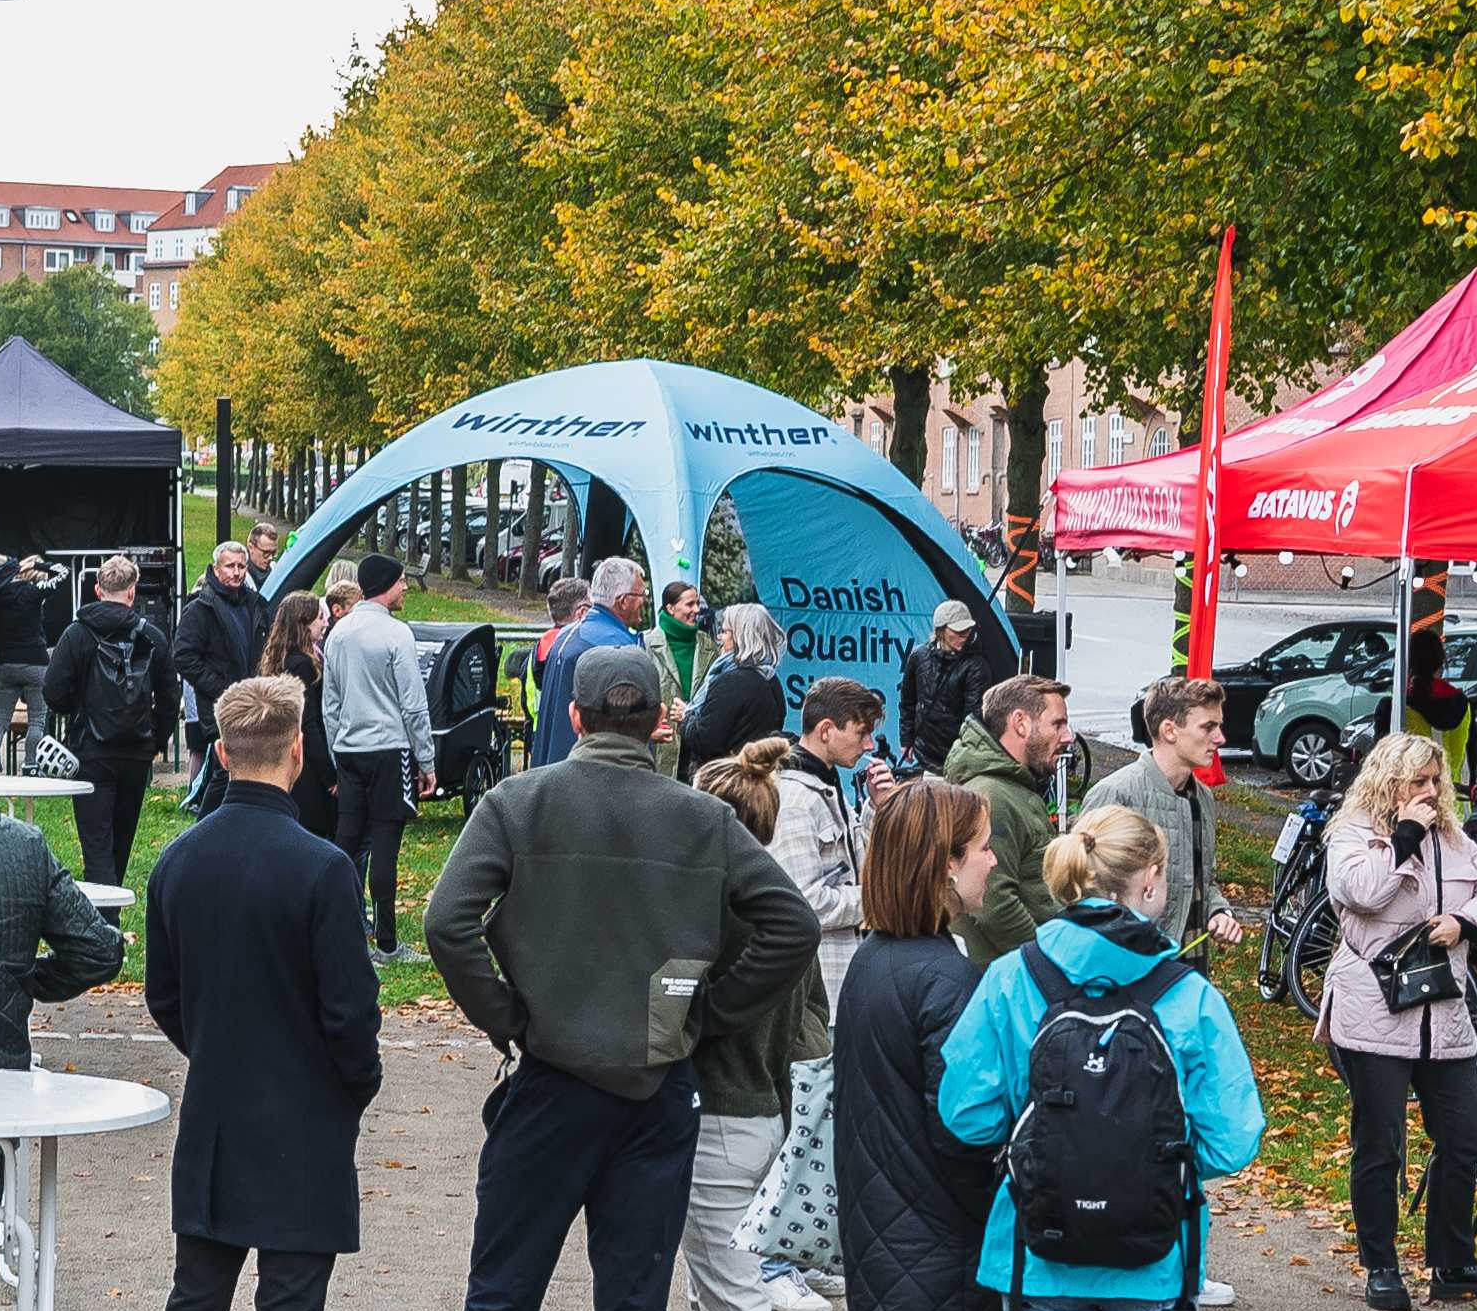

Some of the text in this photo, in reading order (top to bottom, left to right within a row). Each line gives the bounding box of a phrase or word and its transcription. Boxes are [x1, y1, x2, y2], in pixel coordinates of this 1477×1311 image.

[452, 412, 646, 437] winther
[685, 421, 829, 446] winther
[1248, 489, 1336, 521] BATAVUS
[780, 577, 906, 612] Danish
[786, 622, 916, 674] Quality
[1075, 1199, 1107, 1210] TIGHT
